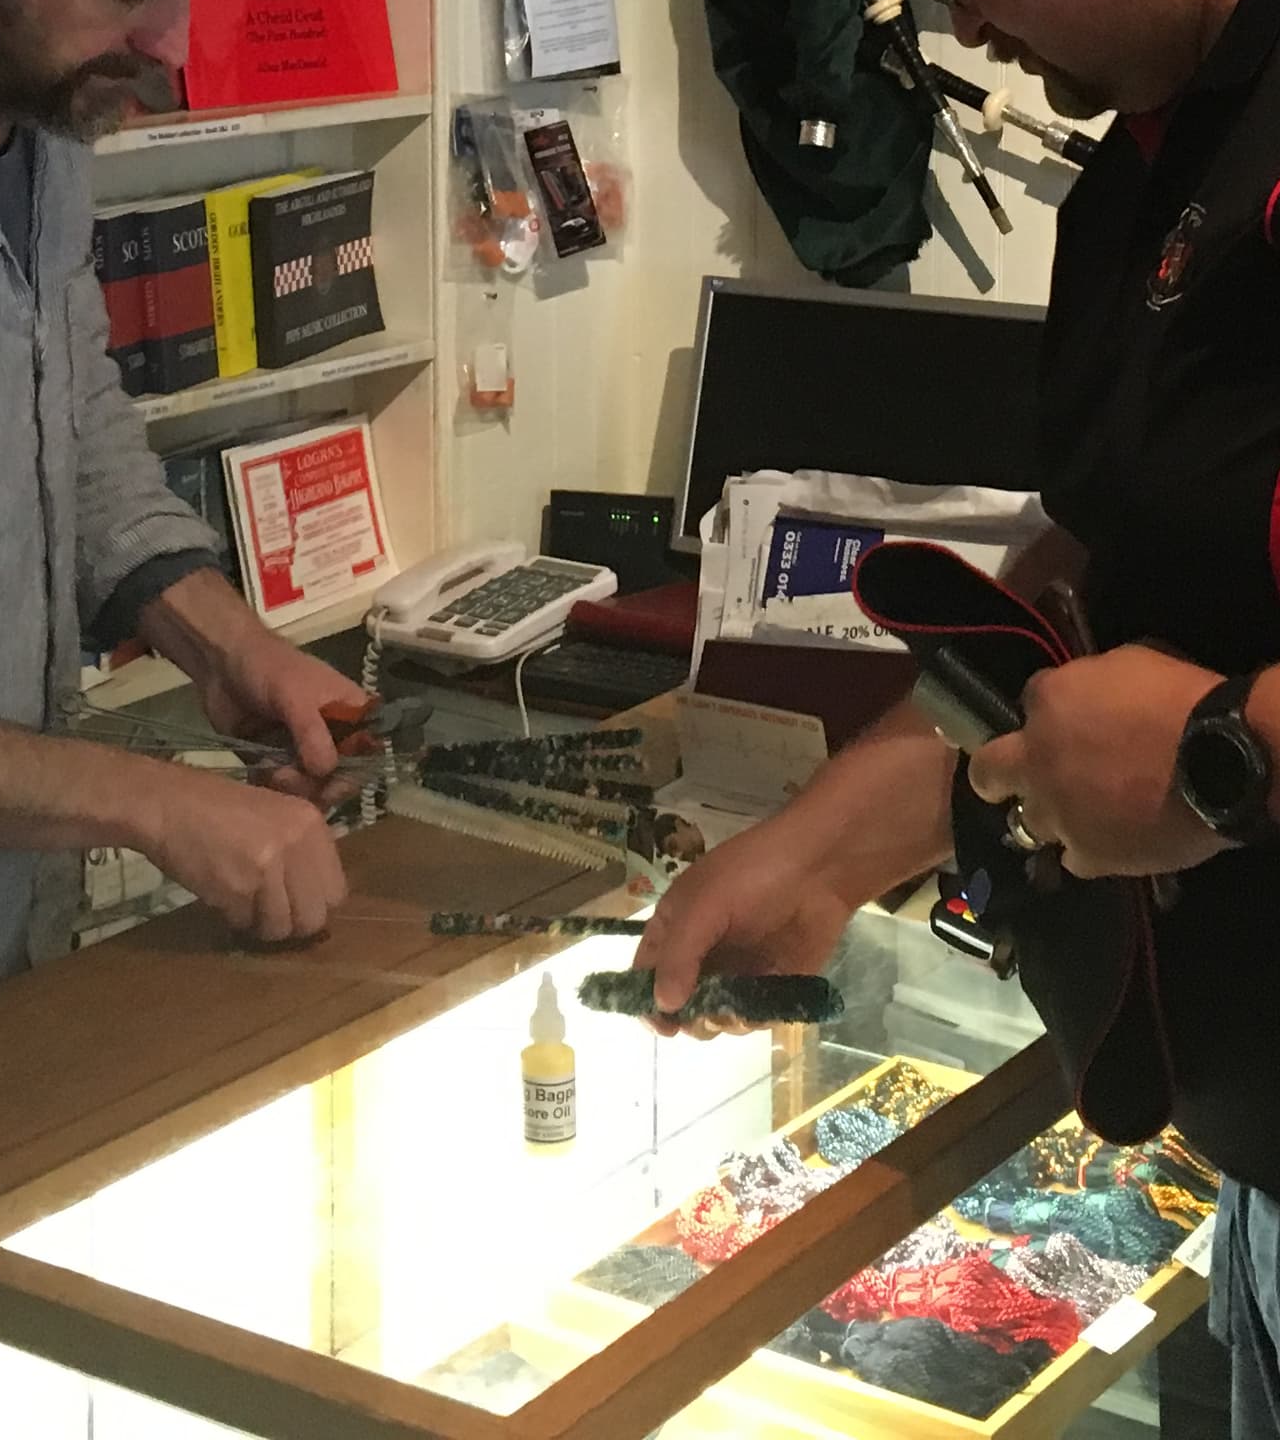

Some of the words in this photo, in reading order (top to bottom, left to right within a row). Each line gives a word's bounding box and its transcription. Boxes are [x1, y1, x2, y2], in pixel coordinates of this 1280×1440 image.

[780, 531, 796, 569] 0333
[841, 625, 870, 640] 20%
[552, 1106, 571, 1119] Oil
